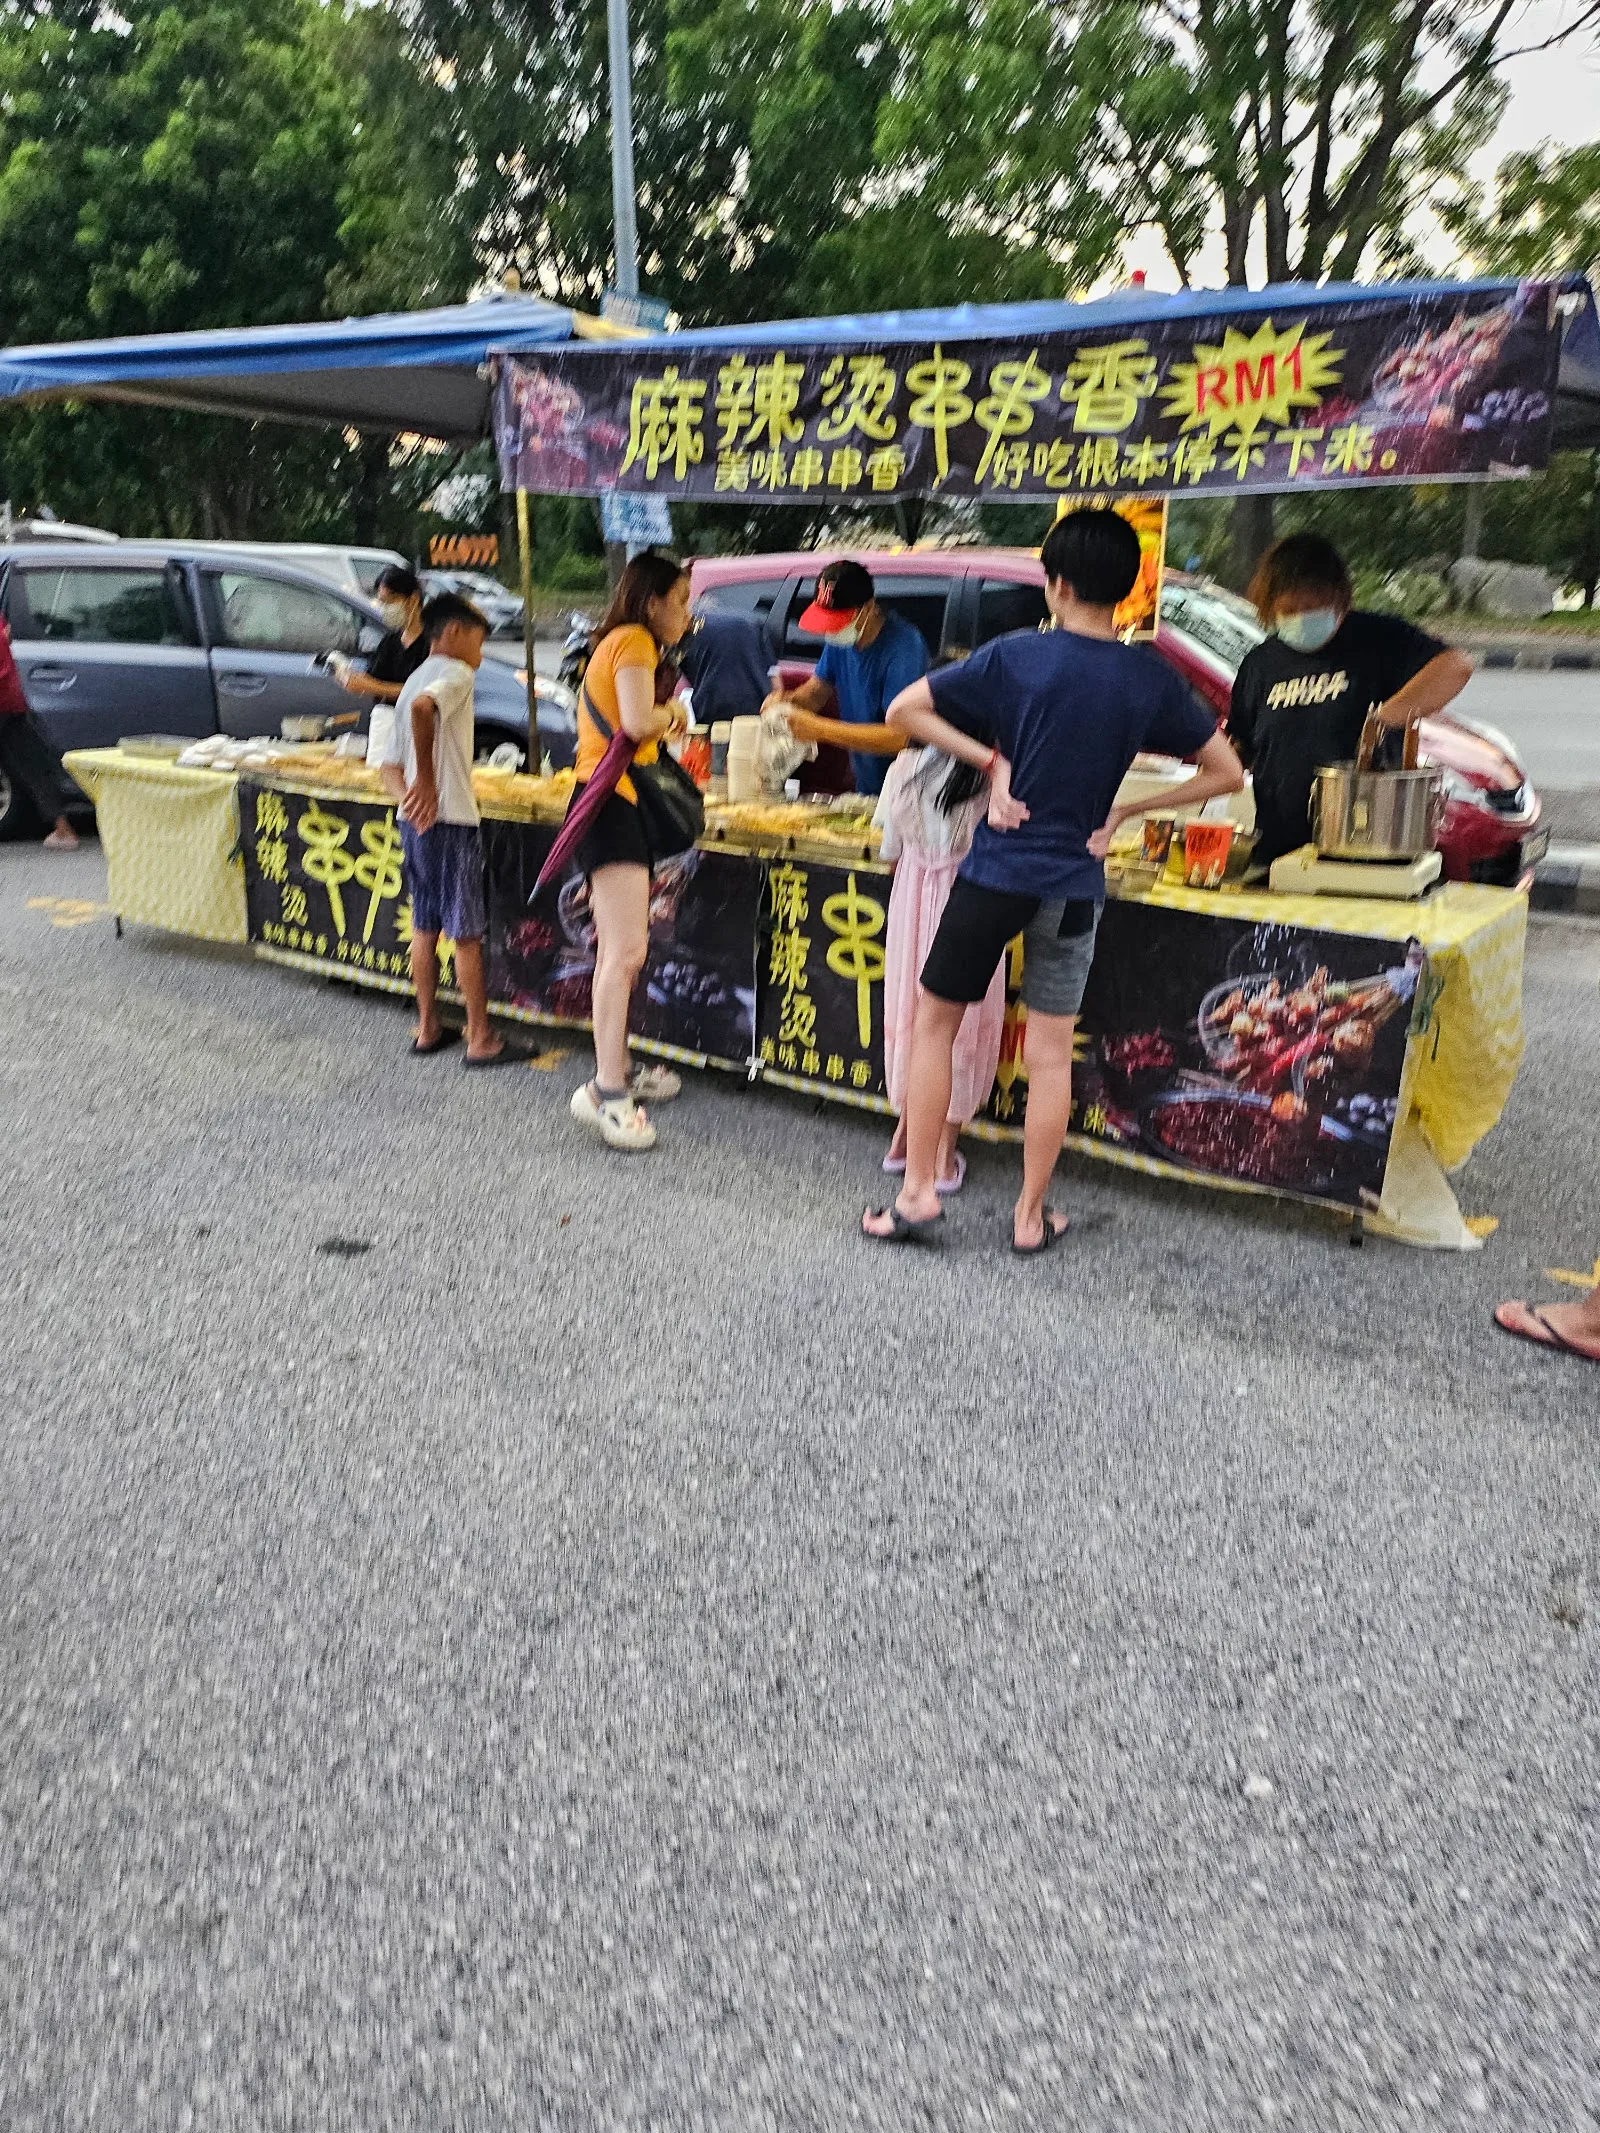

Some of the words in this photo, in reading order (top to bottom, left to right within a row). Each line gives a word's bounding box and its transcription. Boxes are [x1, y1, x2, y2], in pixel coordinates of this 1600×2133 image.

[619, 338, 1158, 489] 麻辣烫串串香
[1194, 338, 1304, 416] RM1
[714, 444, 906, 493] 美味串串香
[768, 861, 817, 1048] 麻辣烫
